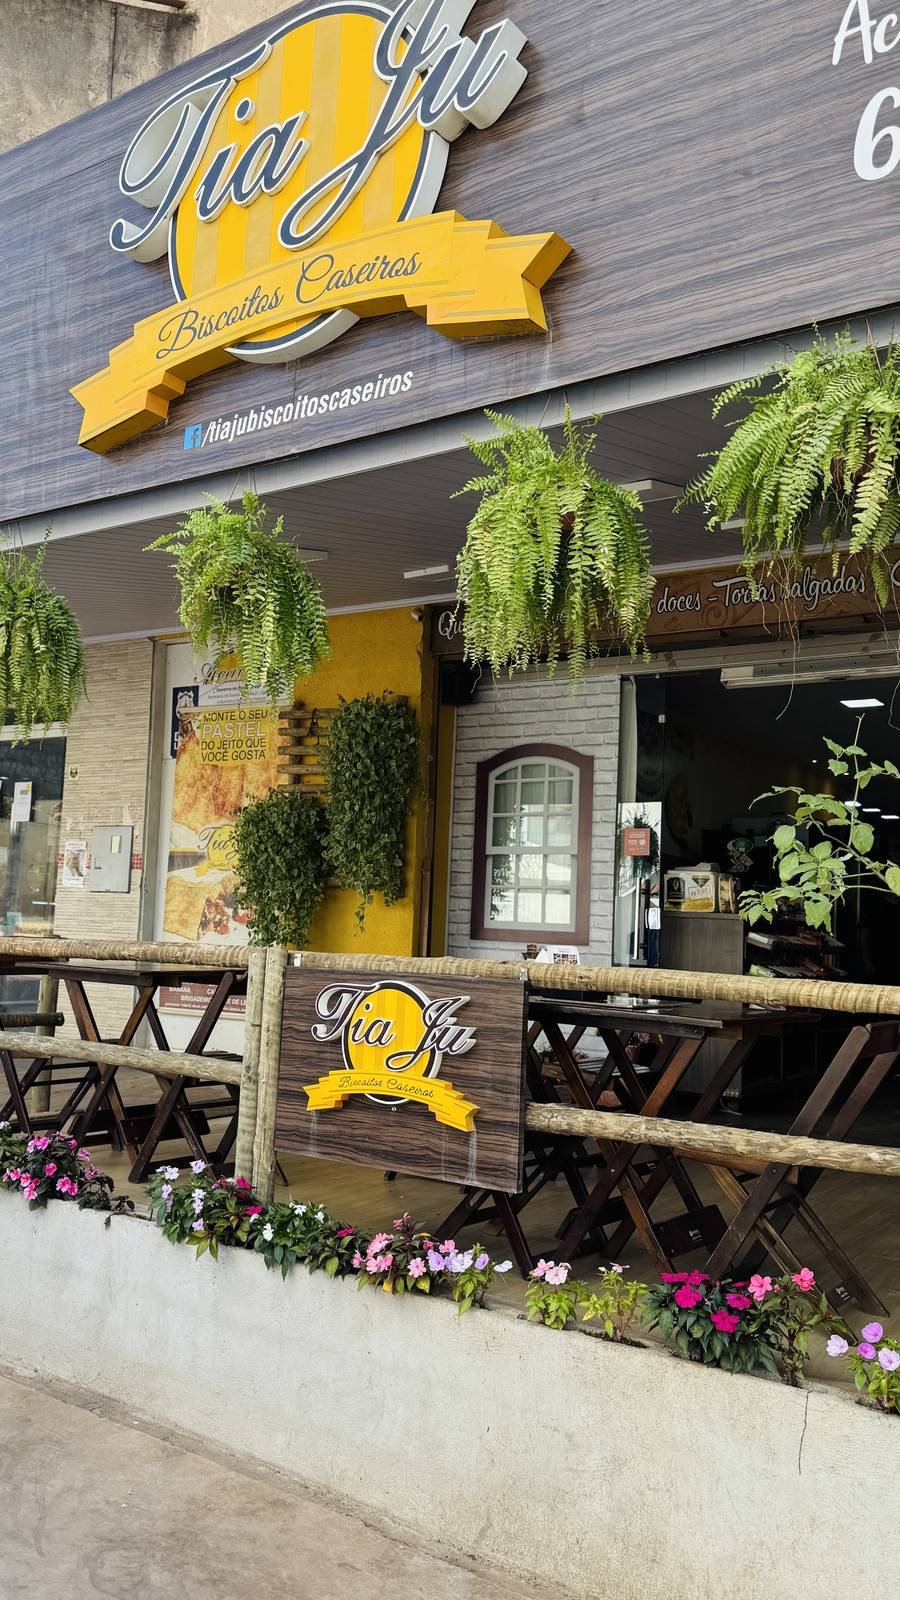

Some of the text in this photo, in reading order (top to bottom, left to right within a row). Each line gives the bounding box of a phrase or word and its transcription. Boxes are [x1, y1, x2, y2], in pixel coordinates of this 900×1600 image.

[109, 0, 516, 251] Tia Ju
[155, 249, 423, 361] Biscoitos Caseiros
[657, 586, 701, 614] doces
[784, 565, 866, 611] salgadas
[203, 709, 268, 722] MONTE O SEU
[202, 721, 267, 739] PASTEL
[201, 738, 266, 751] DO JEITO QUE
[201, 749, 266, 762] VOCÊ GOSTA
[197, 826, 230, 851] Tia
[311, 982, 472, 1071] Tia Ju
[339, 1076, 434, 1098] Biscoitos Caseiros
